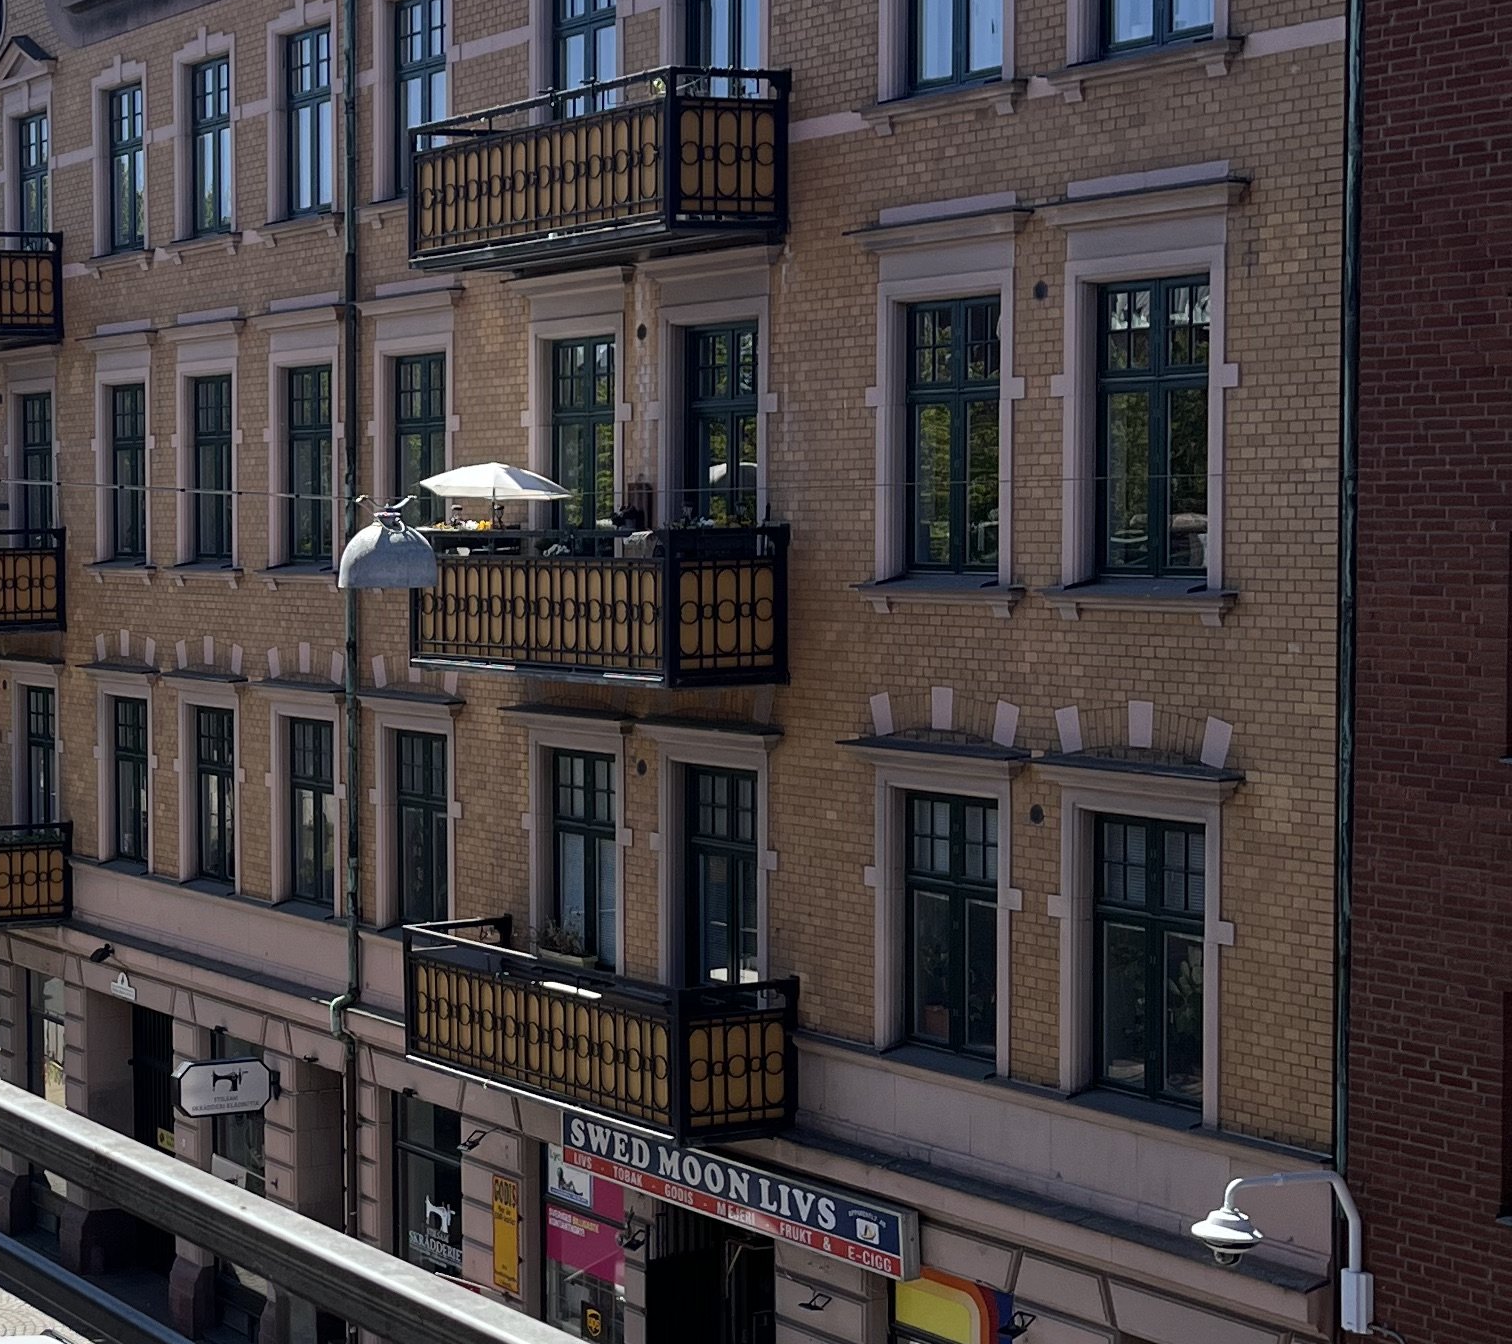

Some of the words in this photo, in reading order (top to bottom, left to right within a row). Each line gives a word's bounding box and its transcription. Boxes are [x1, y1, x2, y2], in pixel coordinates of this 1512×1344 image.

[570, 1117, 650, 1169] SWED
[657, 1146, 750, 1203] MOON
[758, 1178, 837, 1230] LIVS
[573, 1152, 592, 1170] LIVS
[612, 1165, 643, 1188] TOBAK
[664, 1183, 694, 1206] GODIS
[716, 1201, 756, 1226] MEJERI
[779, 1222, 813, 1246] FRUKT
[822, 1236, 832, 1251] &
[847, 1245, 892, 1273] E-CIGG
